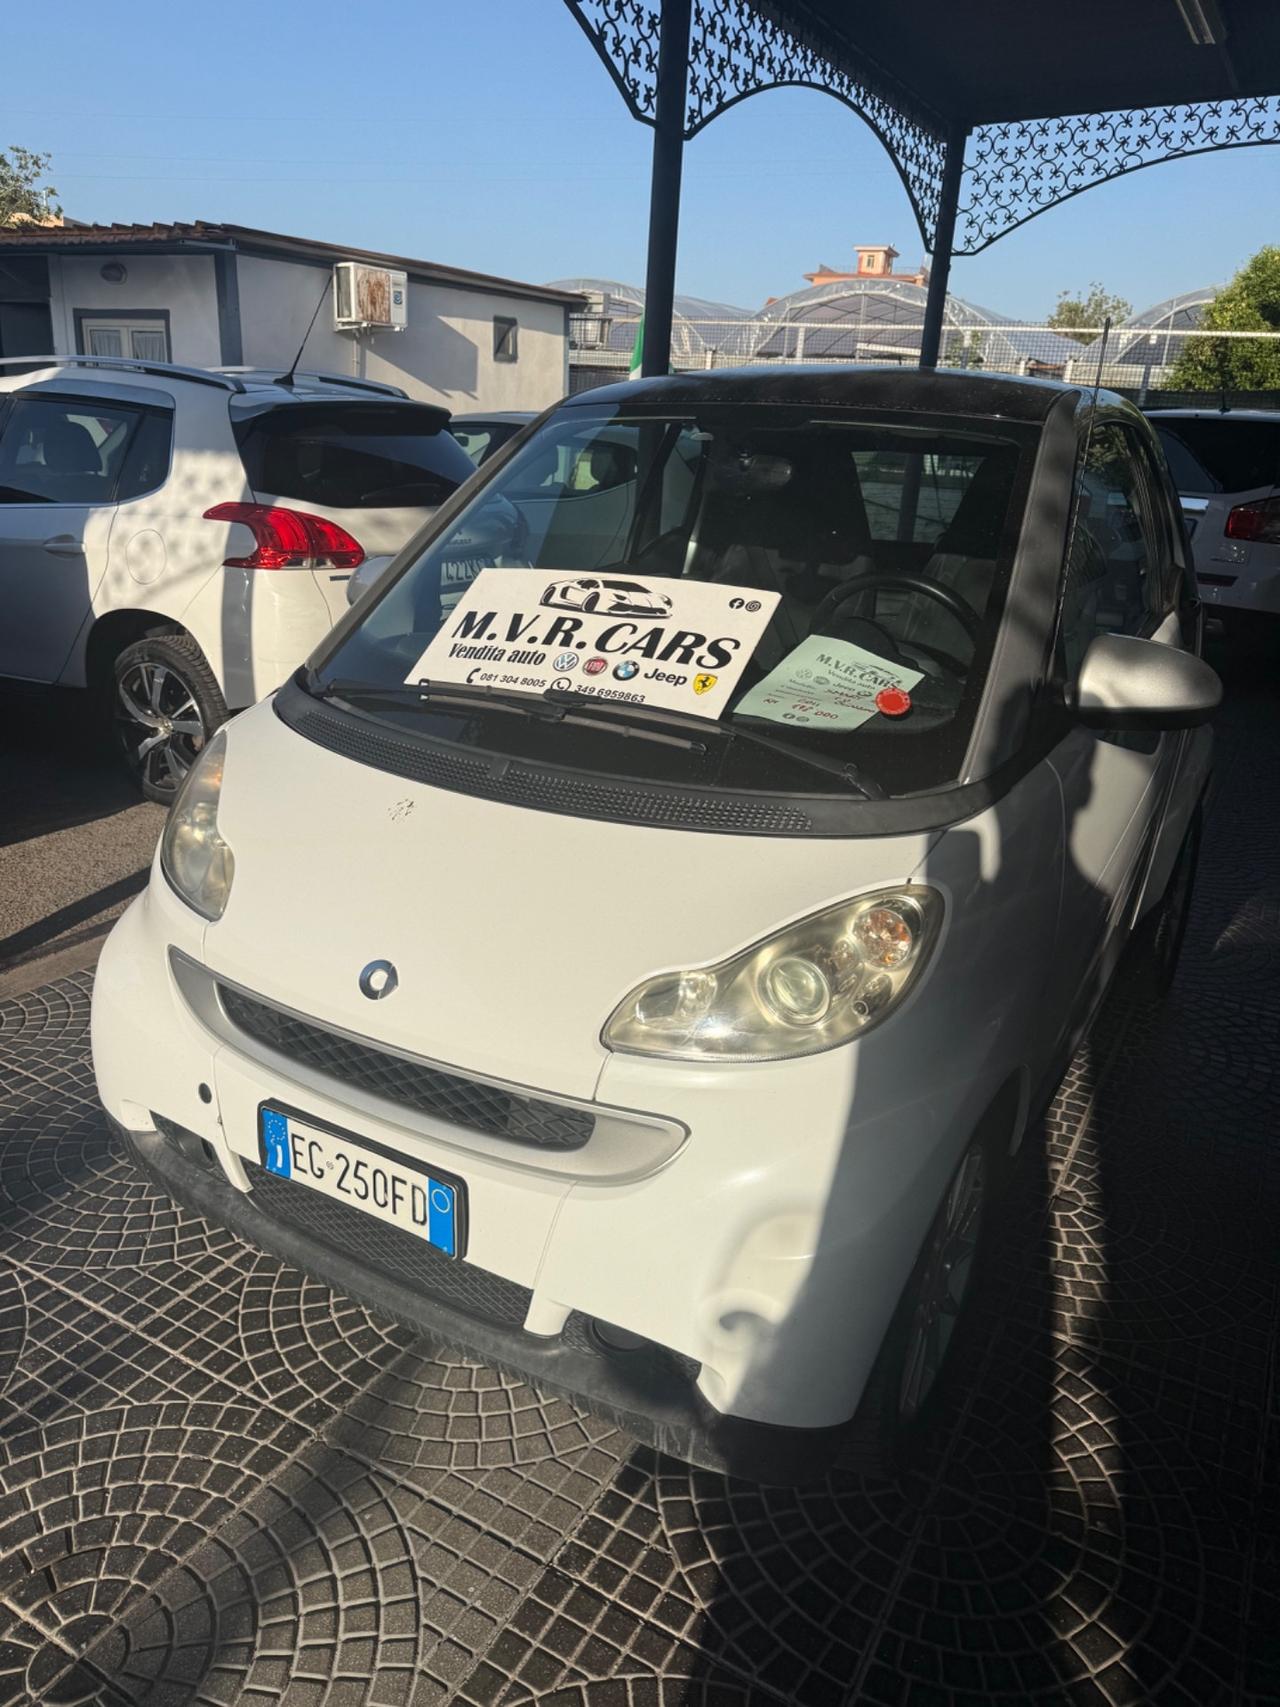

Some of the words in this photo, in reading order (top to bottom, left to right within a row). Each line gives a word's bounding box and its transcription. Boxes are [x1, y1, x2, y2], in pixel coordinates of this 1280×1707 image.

[451, 611, 587, 649] M.V.R.
[594, 622, 741, 669] CARS
[448, 643, 506, 661] Vendita
[507, 650, 546, 666] auto
[480, 673, 498, 682] 081
[500, 675, 519, 684] 304
[520, 678, 547, 688] 8005
[644, 668, 688, 687] Jeep
[574, 684, 596, 695] 349
[596, 688, 646, 703] 6959863
[291, 1132, 325, 1179] EG
[335, 1153, 427, 1226] 250FD
